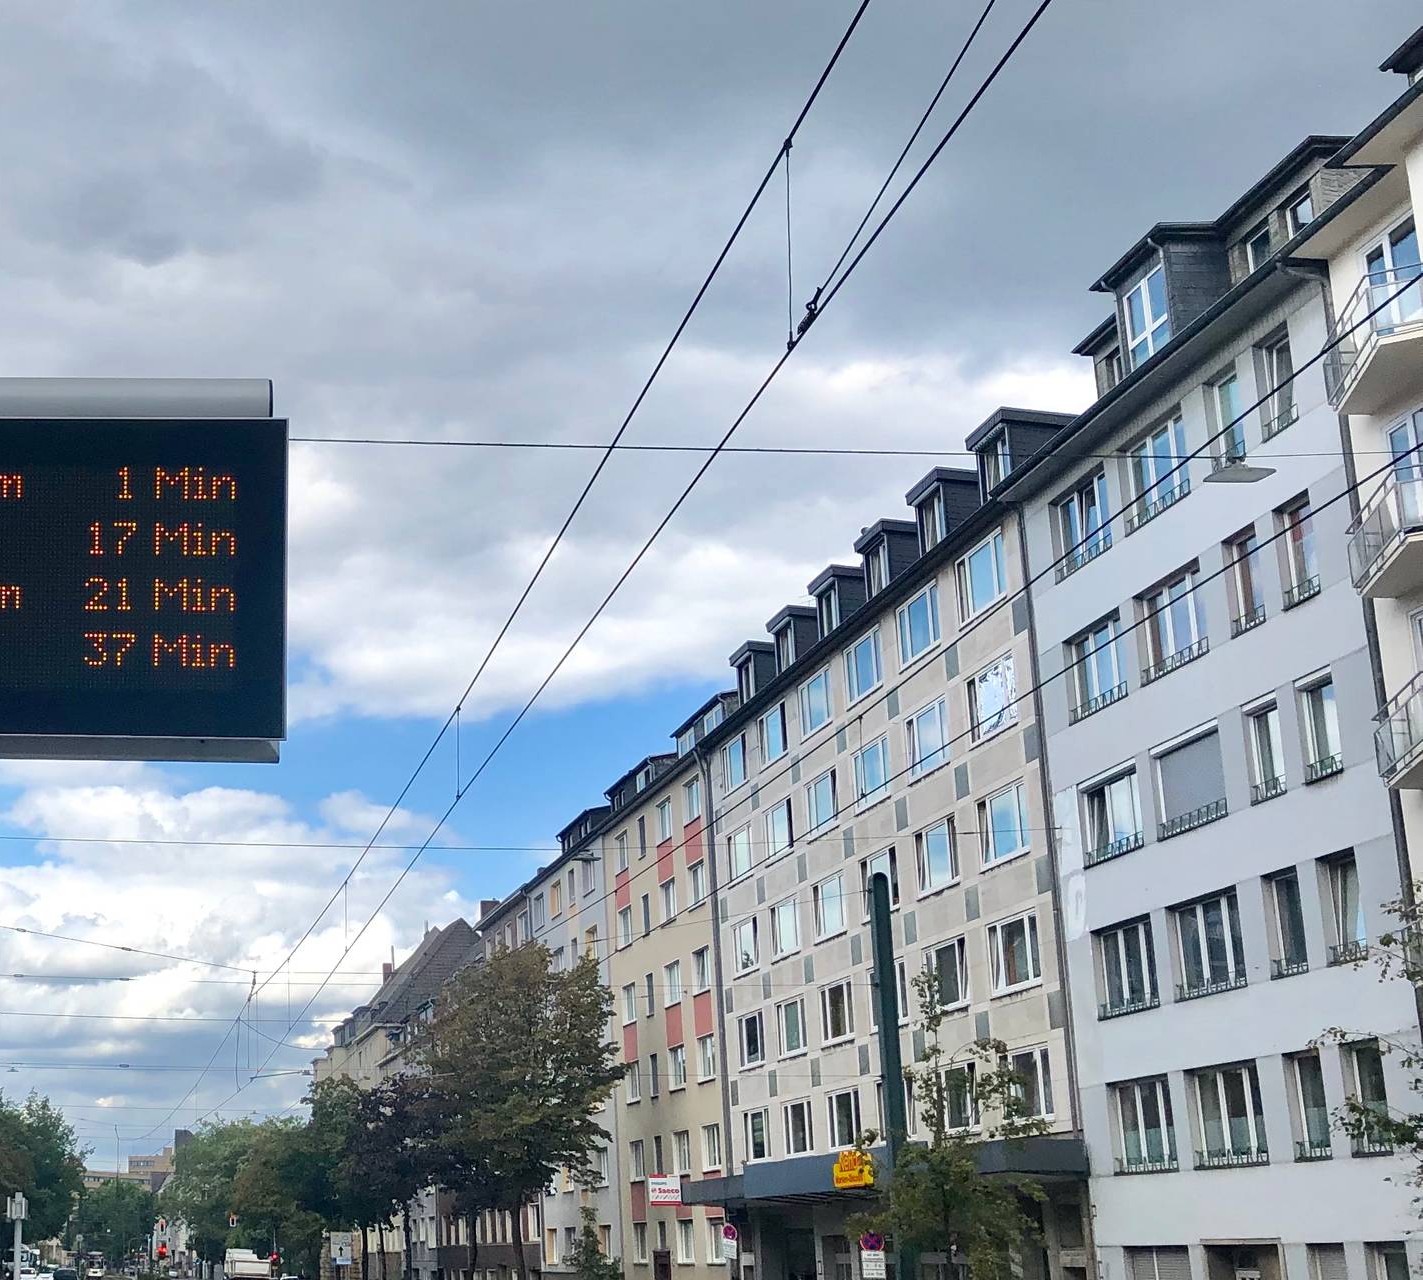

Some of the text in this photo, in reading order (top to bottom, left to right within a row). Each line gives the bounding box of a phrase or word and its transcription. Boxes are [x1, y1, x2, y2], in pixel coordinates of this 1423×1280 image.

[118, 466, 133, 500] 1
[154, 466, 236, 500] Min
[89, 522, 137, 556] 17
[153, 522, 236, 557] Min
[84, 577, 131, 611] 21
[153, 578, 235, 612] Min
[84, 632, 136, 667] 37
[153, 633, 235, 668] Min
